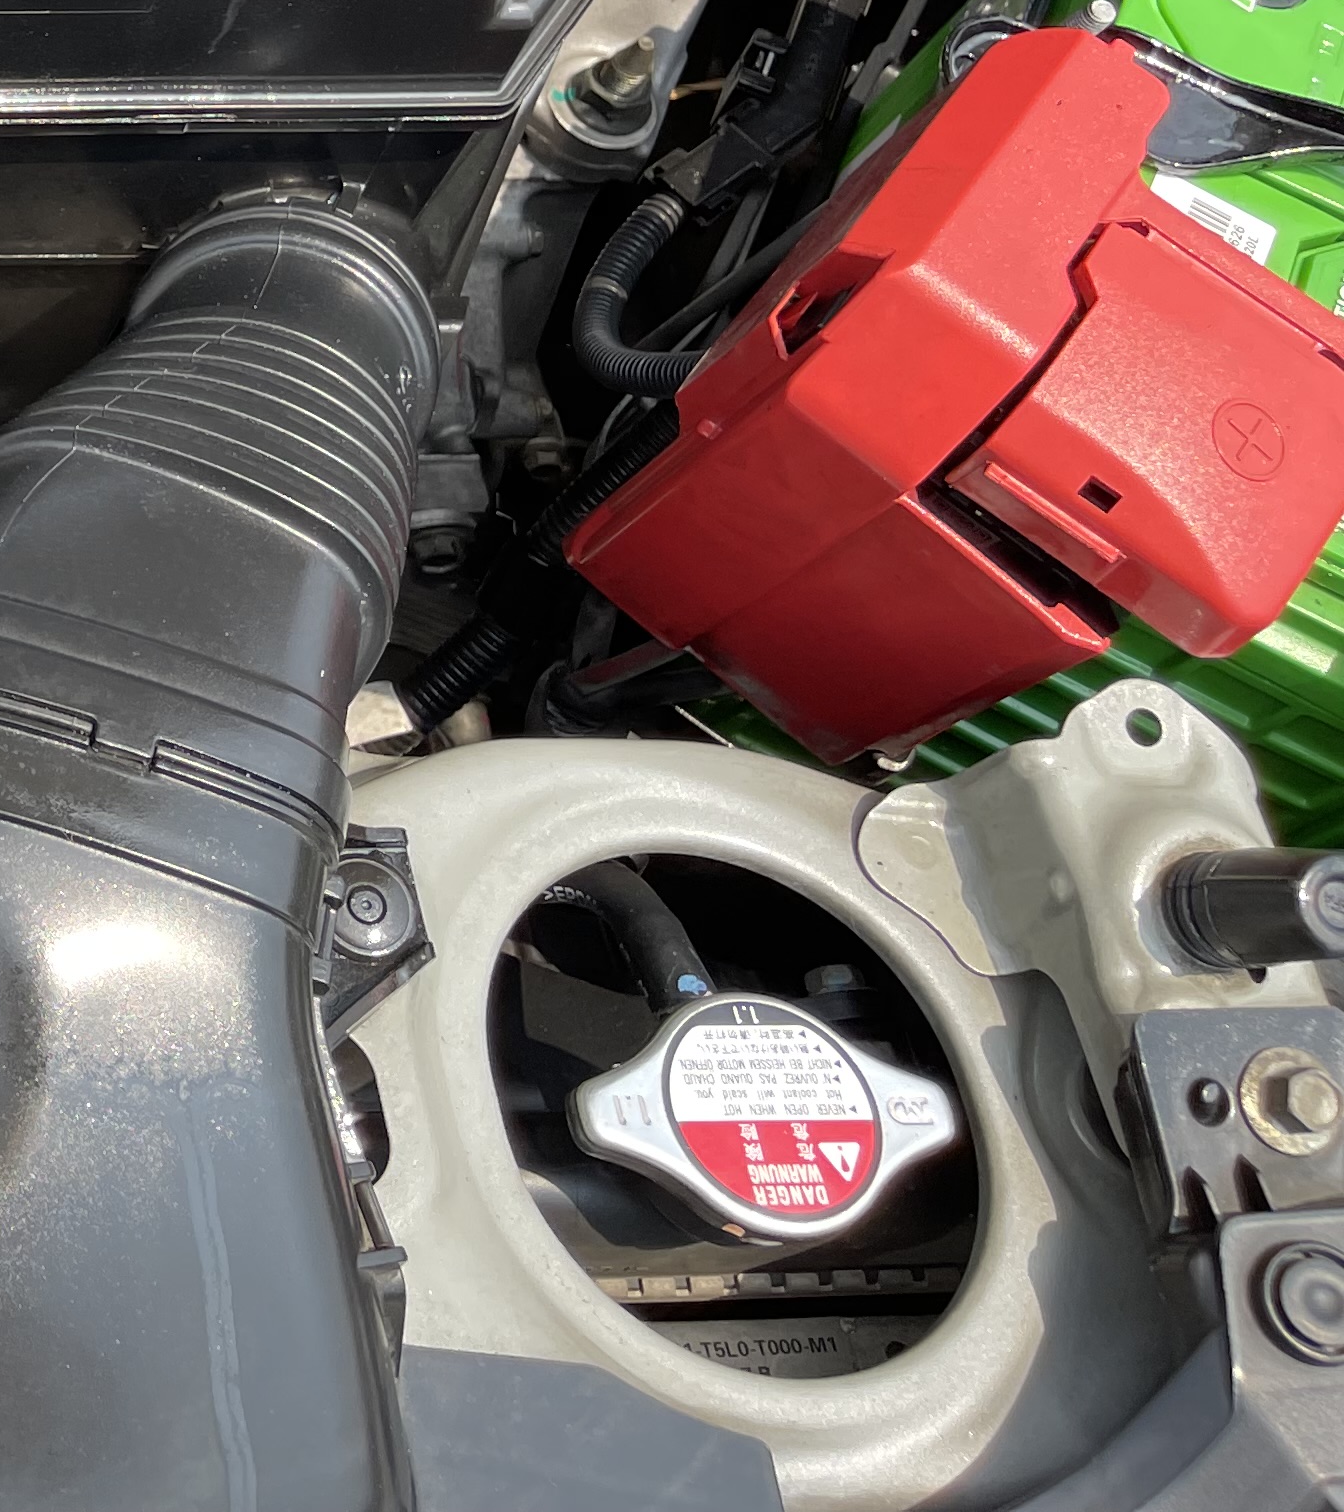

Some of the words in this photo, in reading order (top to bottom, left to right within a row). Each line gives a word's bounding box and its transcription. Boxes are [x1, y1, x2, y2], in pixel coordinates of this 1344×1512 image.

[1227, 223, 1246, 248] 626
[1241, 236, 1260, 261] 20L
[732, 1004, 760, 1025] 1.1
[716, 1058, 745, 1070] MOTOR
[748, 1058, 785, 1070] HEISSEM
[788, 1058, 803, 1070] BEI
[807, 1058, 833, 1070] NICHT
[719, 1072, 753, 1086] QUAND
[757, 1072, 777, 1086] PAS
[721, 1088, 748, 1101] scald
[756, 1088, 776, 1101] will
[781, 1088, 817, 1101] coolant
[824, 1088, 842, 1101] Hot
[722, 1103, 742, 1116] HOT
[748, 1103, 777, 1116] WHEN
[783, 1103, 809, 1116] OPEN
[815, 1103, 846, 1116] NEVER
[746, 1163, 824, 1185] WARNUNG
[751, 1183, 830, 1206] DANGER
